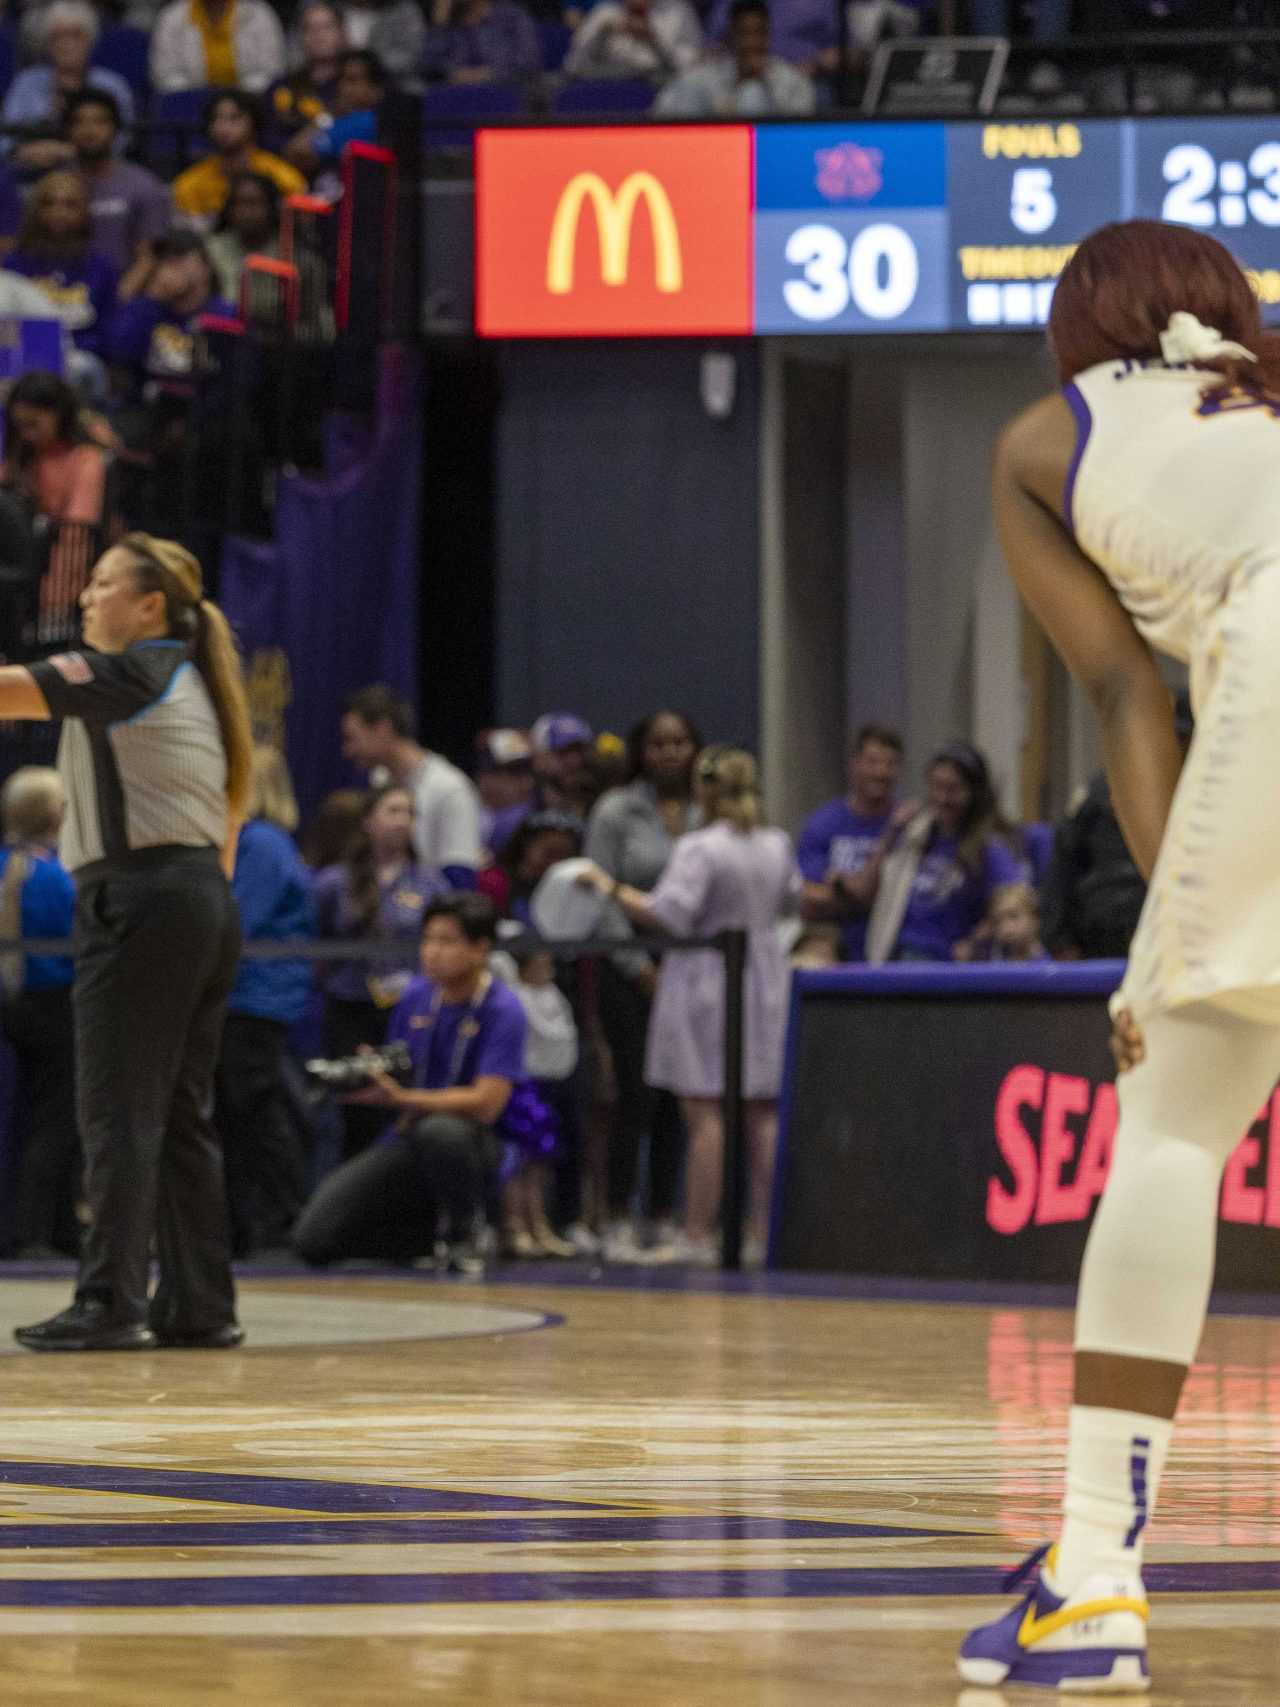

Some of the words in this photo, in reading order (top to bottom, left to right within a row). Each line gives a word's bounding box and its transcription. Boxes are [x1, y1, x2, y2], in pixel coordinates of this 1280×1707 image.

[981, 123, 1083, 160] FOULS
[1009, 167, 1058, 235] 5
[783, 223, 920, 322] 30
